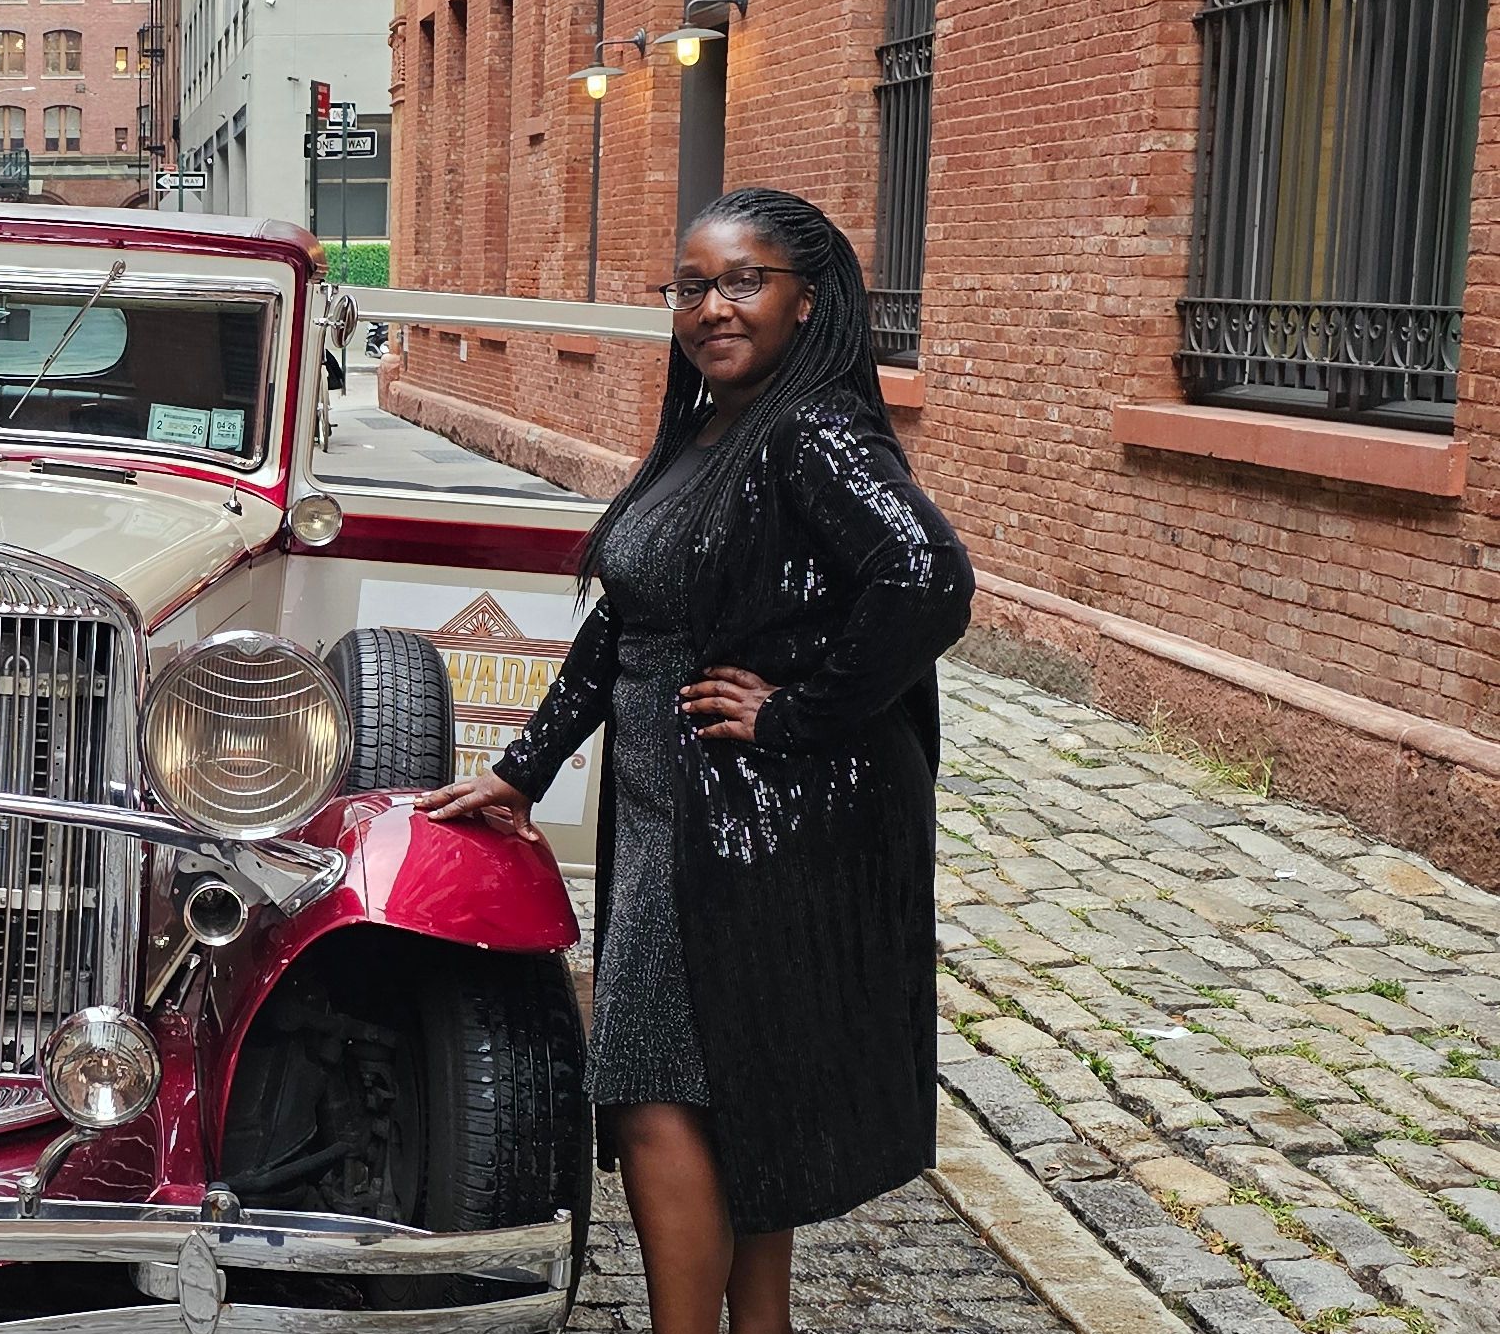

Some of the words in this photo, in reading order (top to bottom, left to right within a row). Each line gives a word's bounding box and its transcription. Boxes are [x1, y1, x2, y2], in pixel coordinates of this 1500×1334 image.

[348, 138, 368, 149] WAY
[156, 420, 163, 430] 2
[192, 424, 203, 436] 26
[464, 724, 501, 746] CAR
